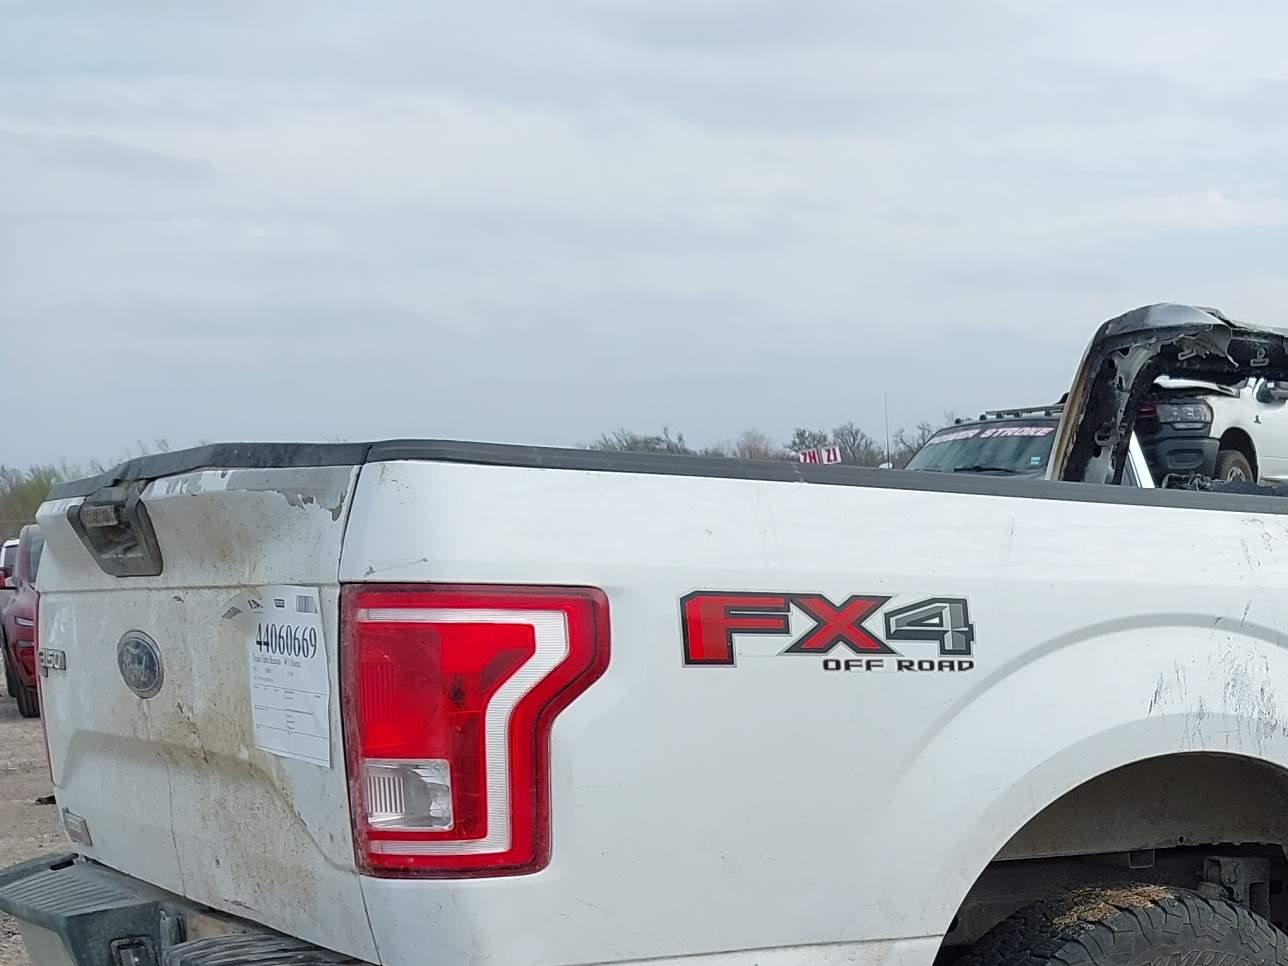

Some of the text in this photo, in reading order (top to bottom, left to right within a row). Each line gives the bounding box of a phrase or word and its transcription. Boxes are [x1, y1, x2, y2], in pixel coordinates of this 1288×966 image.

[980, 427, 1056, 438] STROKE
[680, 591, 974, 665] FX4
[255, 623, 317, 659] 44060669
[823, 659, 975, 672] OFF ROAD
